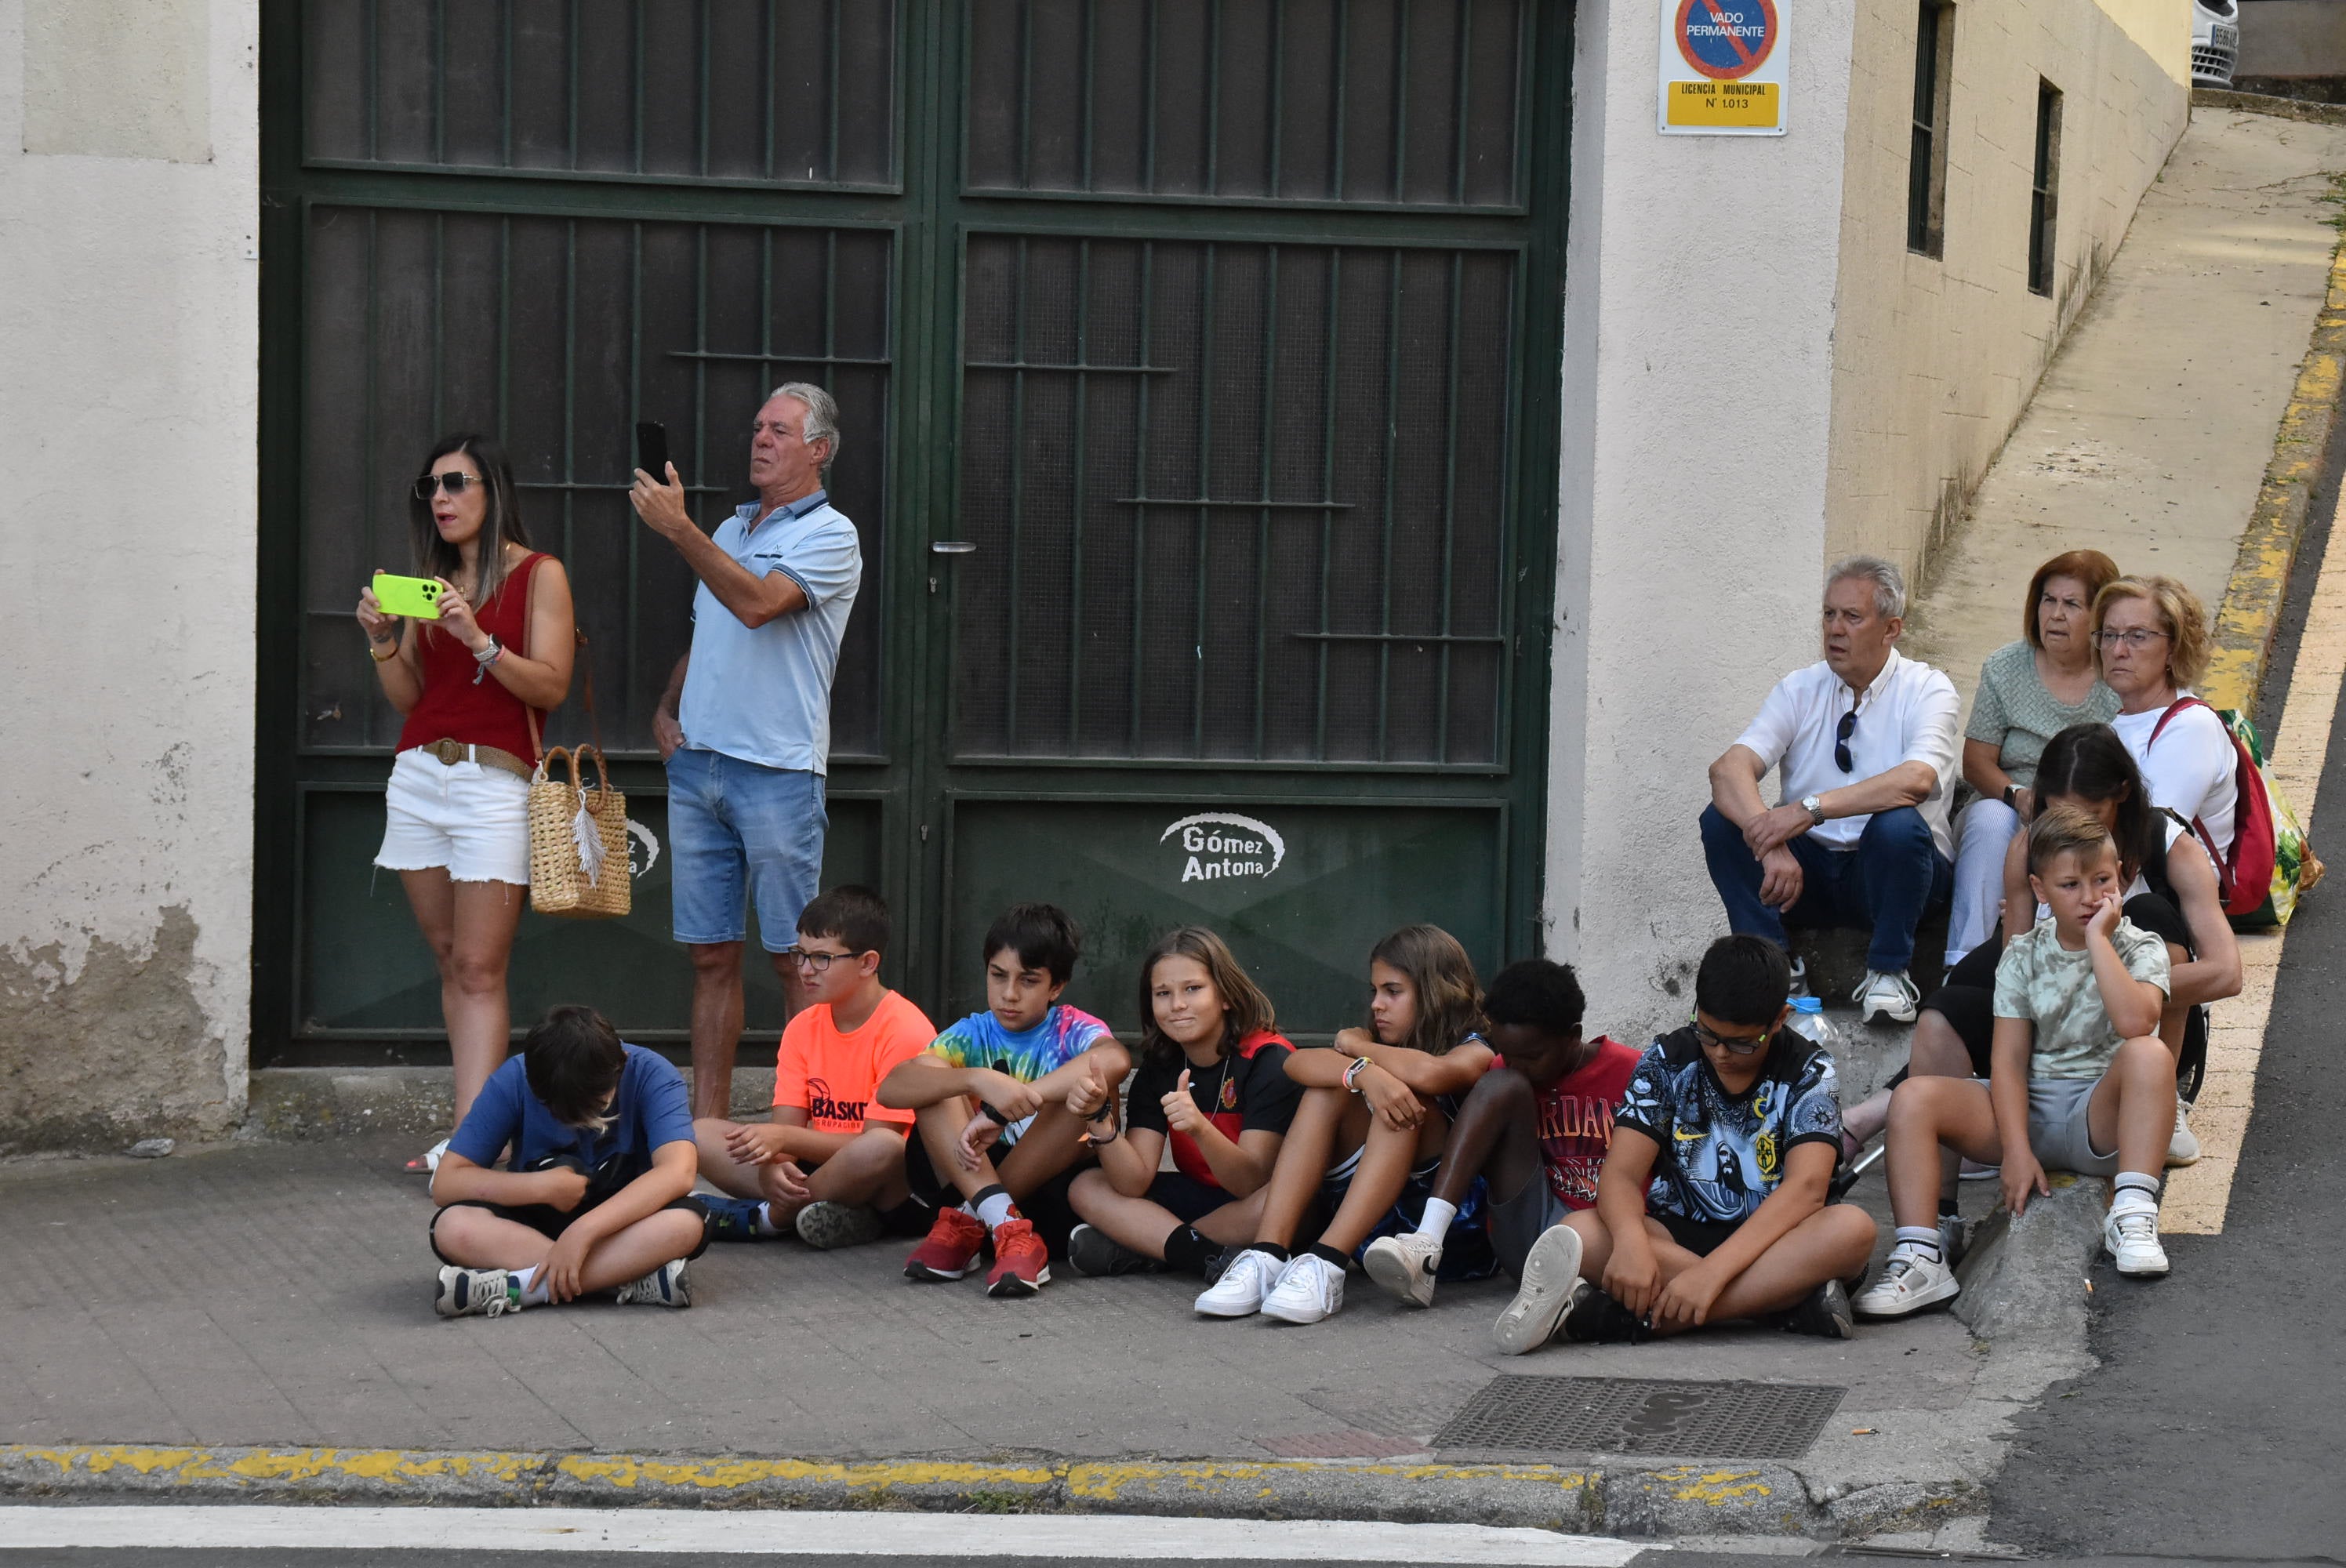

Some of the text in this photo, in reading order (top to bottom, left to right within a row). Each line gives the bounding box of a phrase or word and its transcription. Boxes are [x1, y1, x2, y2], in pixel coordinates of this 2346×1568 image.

[1710, 13, 1743, 24] VADO
[1687, 25, 1764, 37] PERMANENTE
[1681, 84, 1766, 96] LICENCIA MUNICIPAL
[1722, 99, 1749, 109] 1.013
[1182, 826, 1263, 854] Gómez
[1182, 855, 1264, 883] Antona
[1537, 1095, 1622, 1149] RDAN
